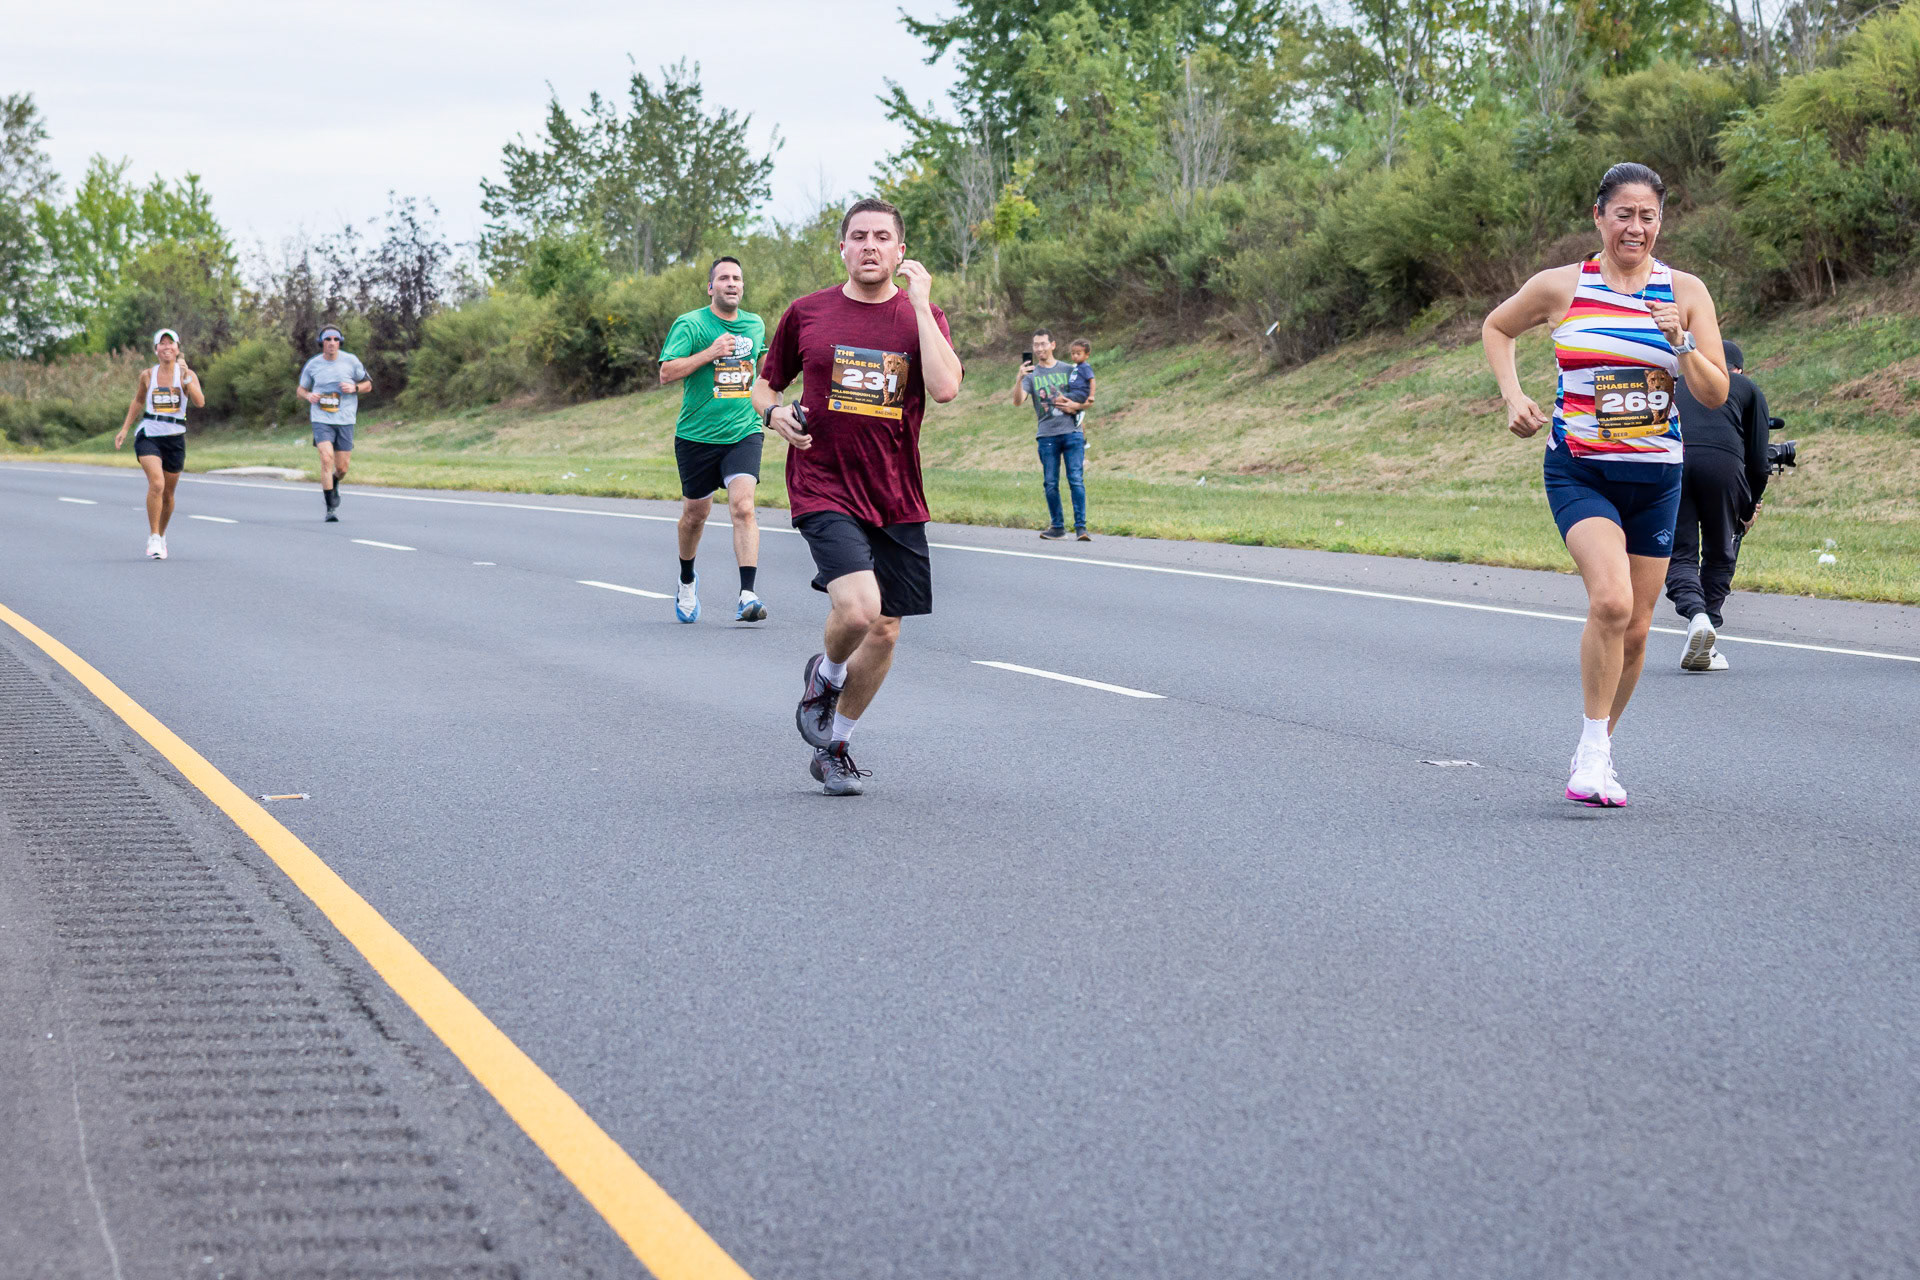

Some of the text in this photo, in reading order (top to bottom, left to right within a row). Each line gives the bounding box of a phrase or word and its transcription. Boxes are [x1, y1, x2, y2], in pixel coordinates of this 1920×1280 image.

[836, 349, 855, 357] THE
[835, 358, 867, 367] CHASE
[718, 371, 751, 384] 697
[841, 368, 898, 393] 231
[1595, 374, 1615, 382] THE
[1595, 382, 1629, 391] CHASE
[1601, 390, 1670, 413] 269
